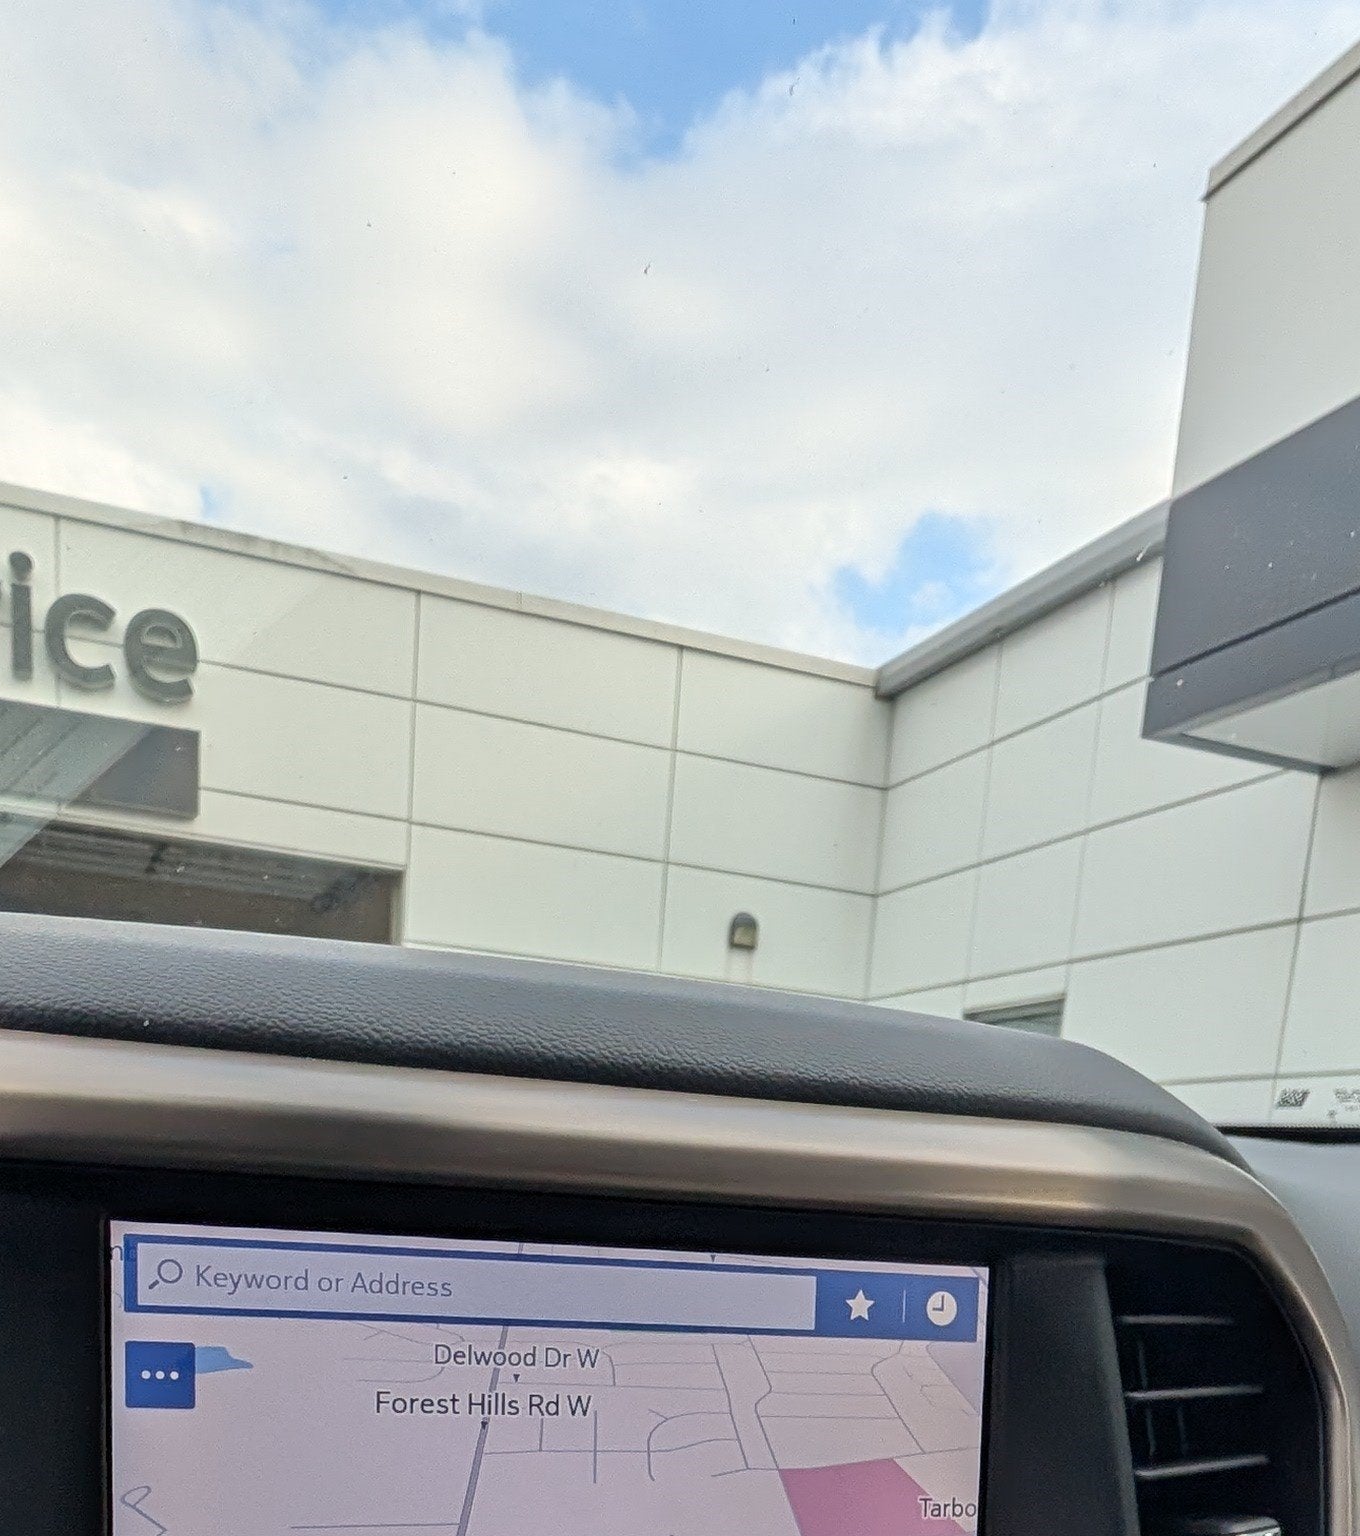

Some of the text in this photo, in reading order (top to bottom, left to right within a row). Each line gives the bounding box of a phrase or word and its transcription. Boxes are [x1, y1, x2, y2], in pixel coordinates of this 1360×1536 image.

[194, 1264, 454, 1298] Keyword or Address
[434, 1344, 600, 1369] Delwood Dr W
[376, 1390, 592, 1417] Forest Hills Rd W
[919, 1497, 977, 1518] Tarbo
